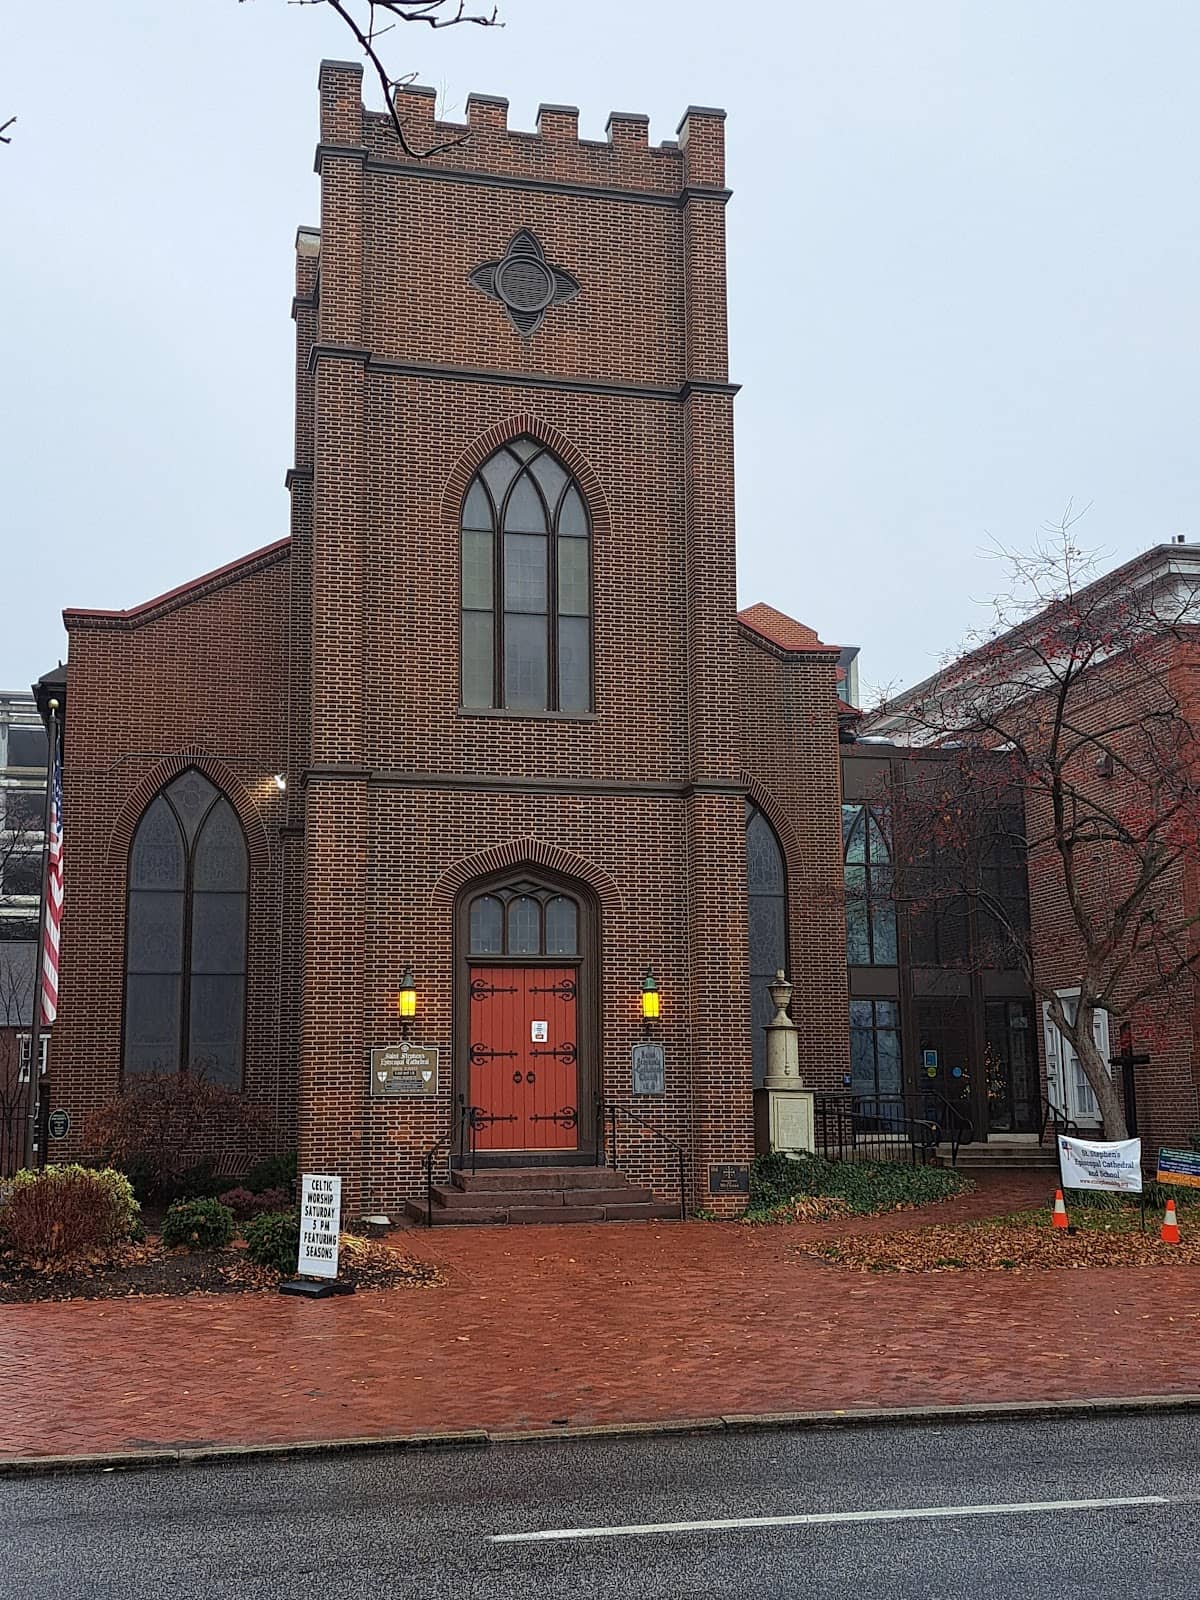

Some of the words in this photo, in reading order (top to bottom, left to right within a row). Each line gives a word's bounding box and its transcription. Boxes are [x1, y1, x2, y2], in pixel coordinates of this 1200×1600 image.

[1090, 1150, 1121, 1159] Stephen's
[1074, 1159, 1101, 1168] Episcopal
[311, 1179, 333, 1191] CELTIC
[307, 1193, 334, 1205] WORSHIP
[304, 1205, 336, 1218] SATURDAY
[312, 1219, 317, 1230] 5
[320, 1220, 330, 1231] PM
[303, 1231, 337, 1246] FEATURING
[305, 1246, 333, 1259] SEASONS
